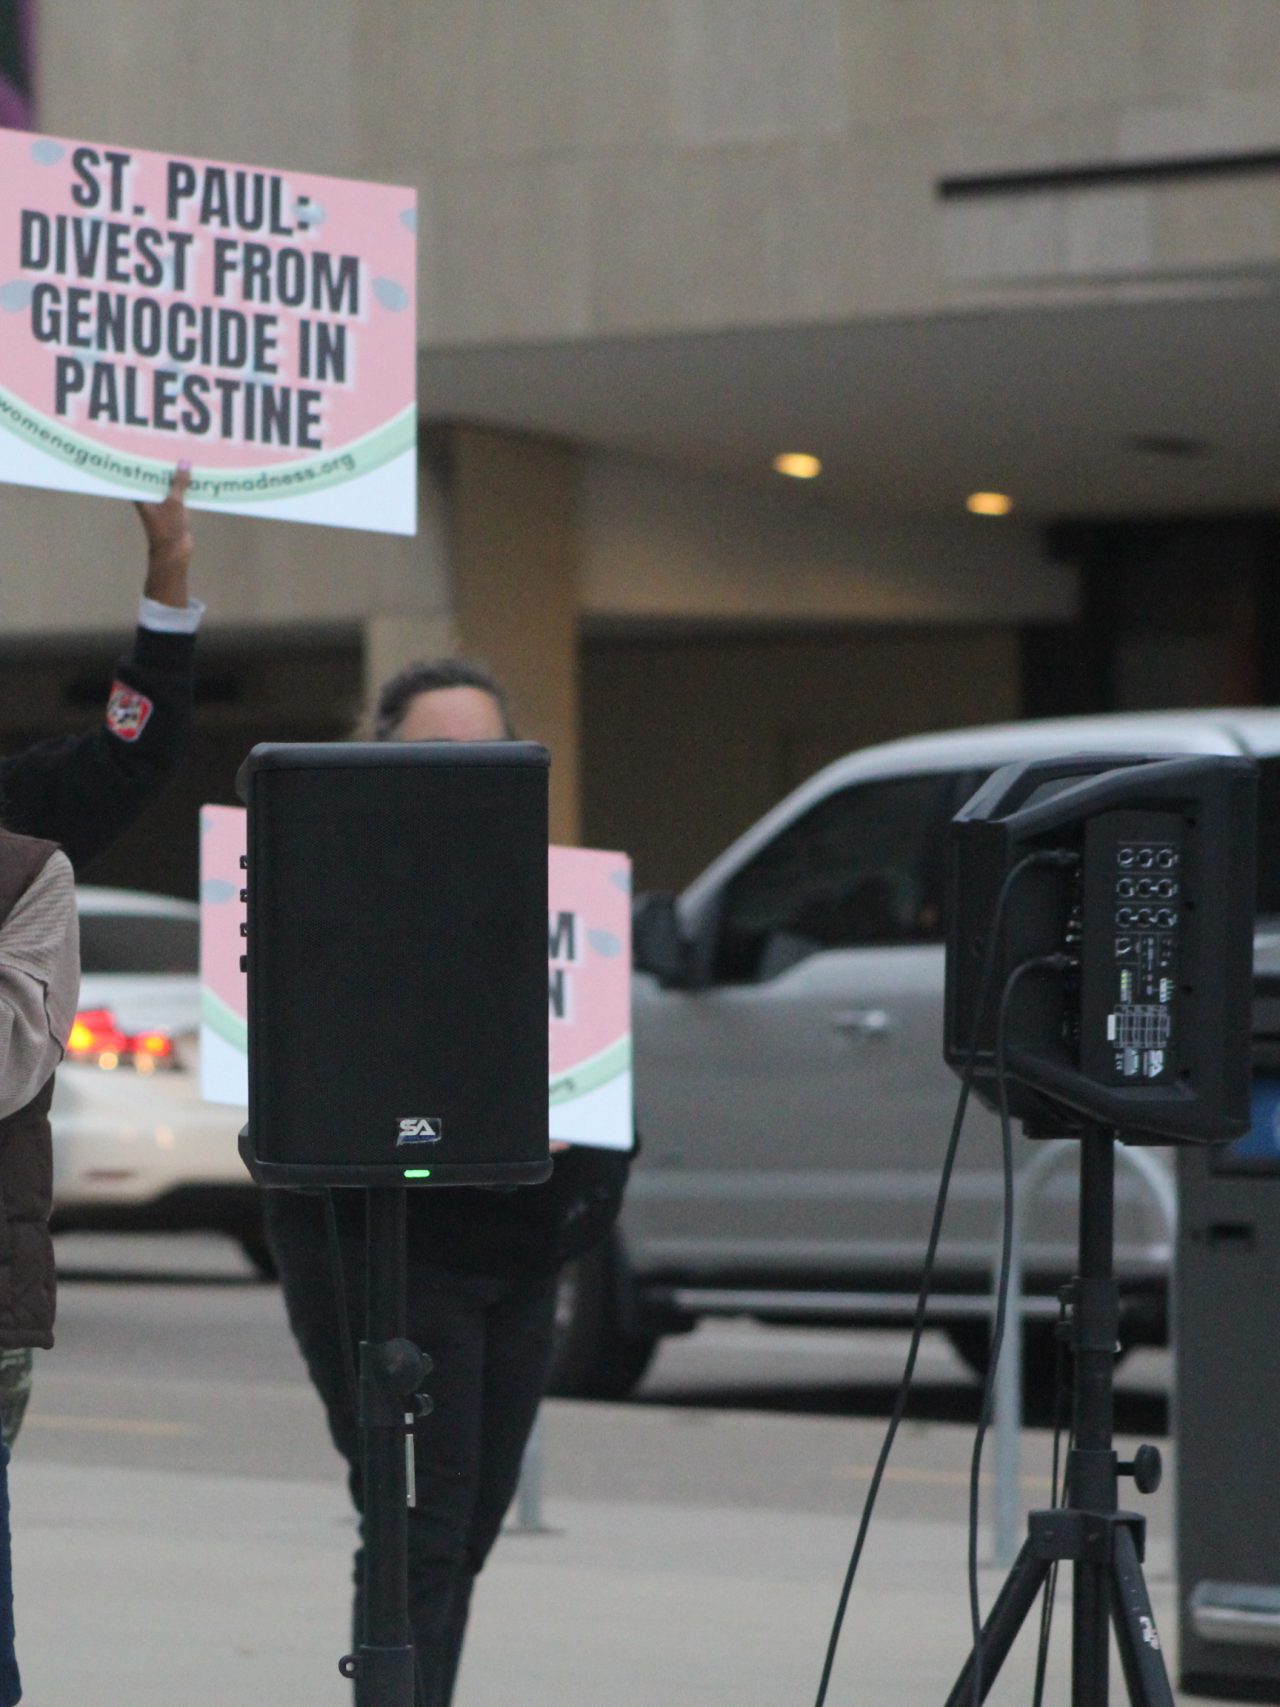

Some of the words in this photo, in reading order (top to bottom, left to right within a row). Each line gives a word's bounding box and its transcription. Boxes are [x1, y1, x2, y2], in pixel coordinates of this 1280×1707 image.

[71, 147, 145, 216] ST.
[167, 160, 311, 237] PAUL:
[20, 209, 194, 292] DIVEST
[214, 237, 360, 315] FROM
[31, 282, 278, 375] GENOCIDE
[298, 318, 347, 384] IN
[54, 355, 323, 450] PALESTINE
[399, 1118, 436, 1136] SA
